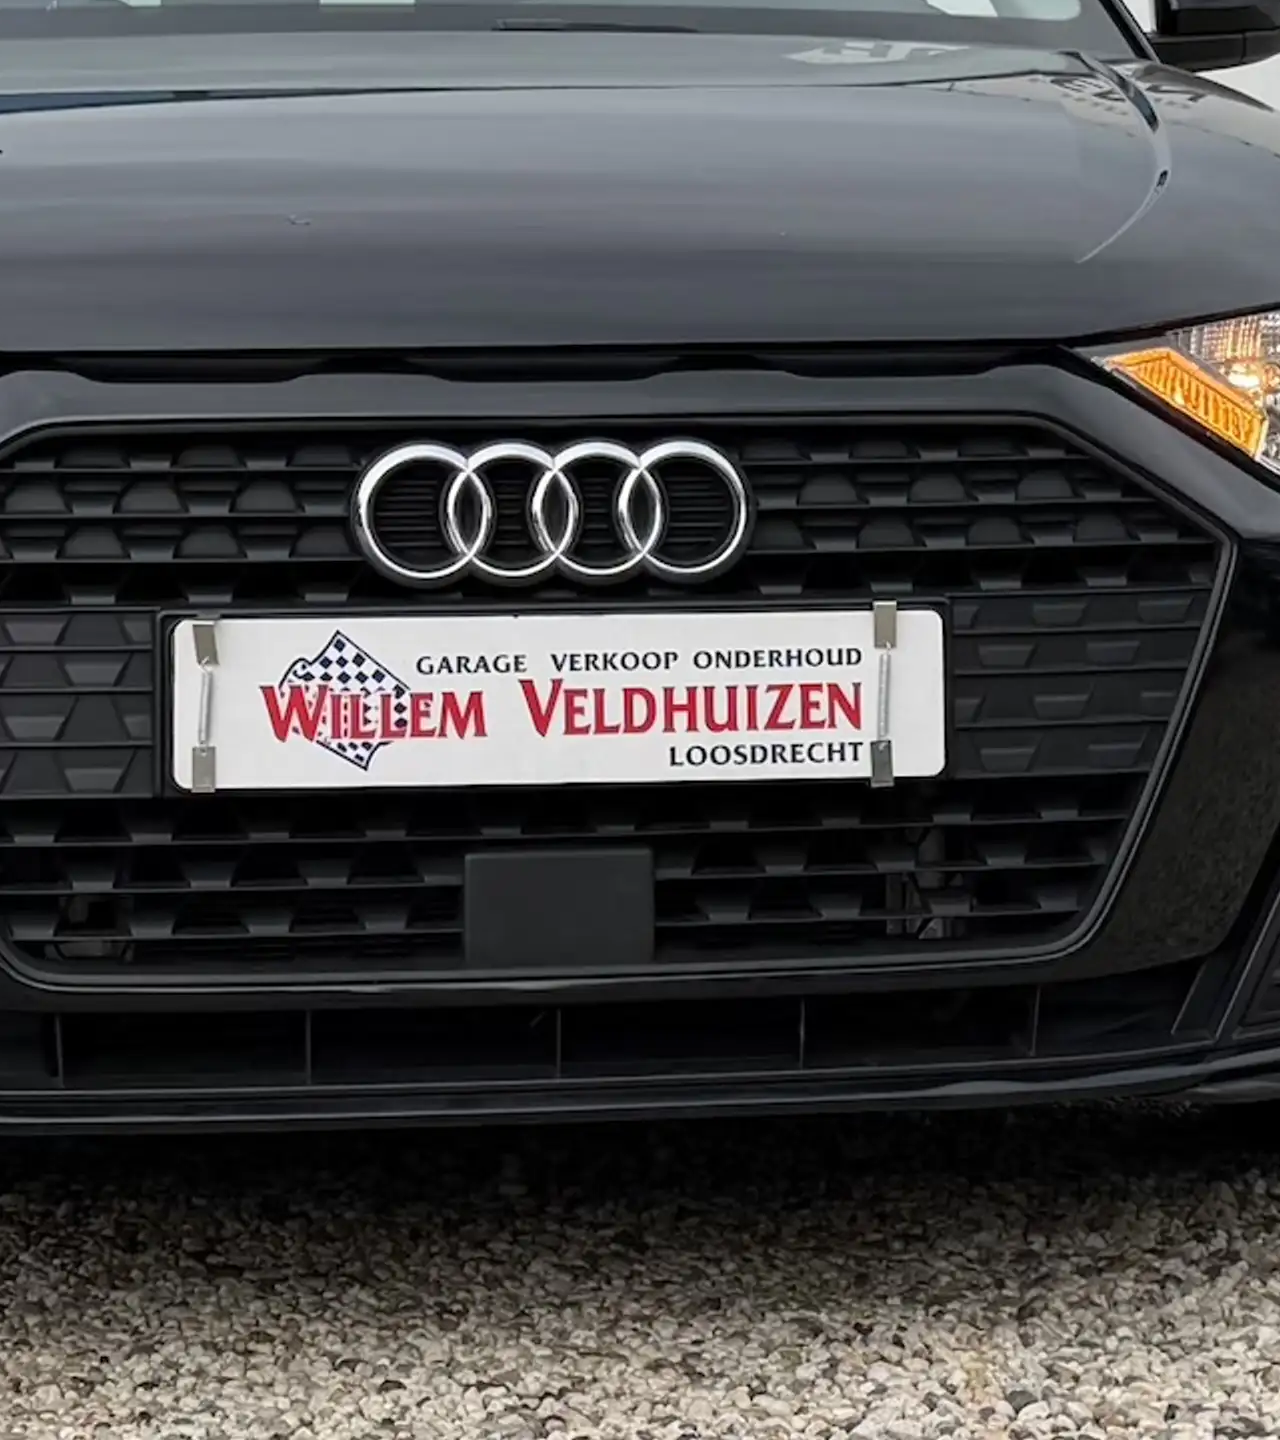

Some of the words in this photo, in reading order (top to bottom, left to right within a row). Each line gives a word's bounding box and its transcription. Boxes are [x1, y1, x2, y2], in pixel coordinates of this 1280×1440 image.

[416, 654, 527, 675] GARAGE
[551, 651, 679, 673] VERKOOP
[693, 647, 863, 671] ONDERHOUD
[259, 684, 488, 742] WILLEM
[518, 677, 863, 738] VELDHUIZEN
[669, 741, 864, 767] LOOSDRECHT
